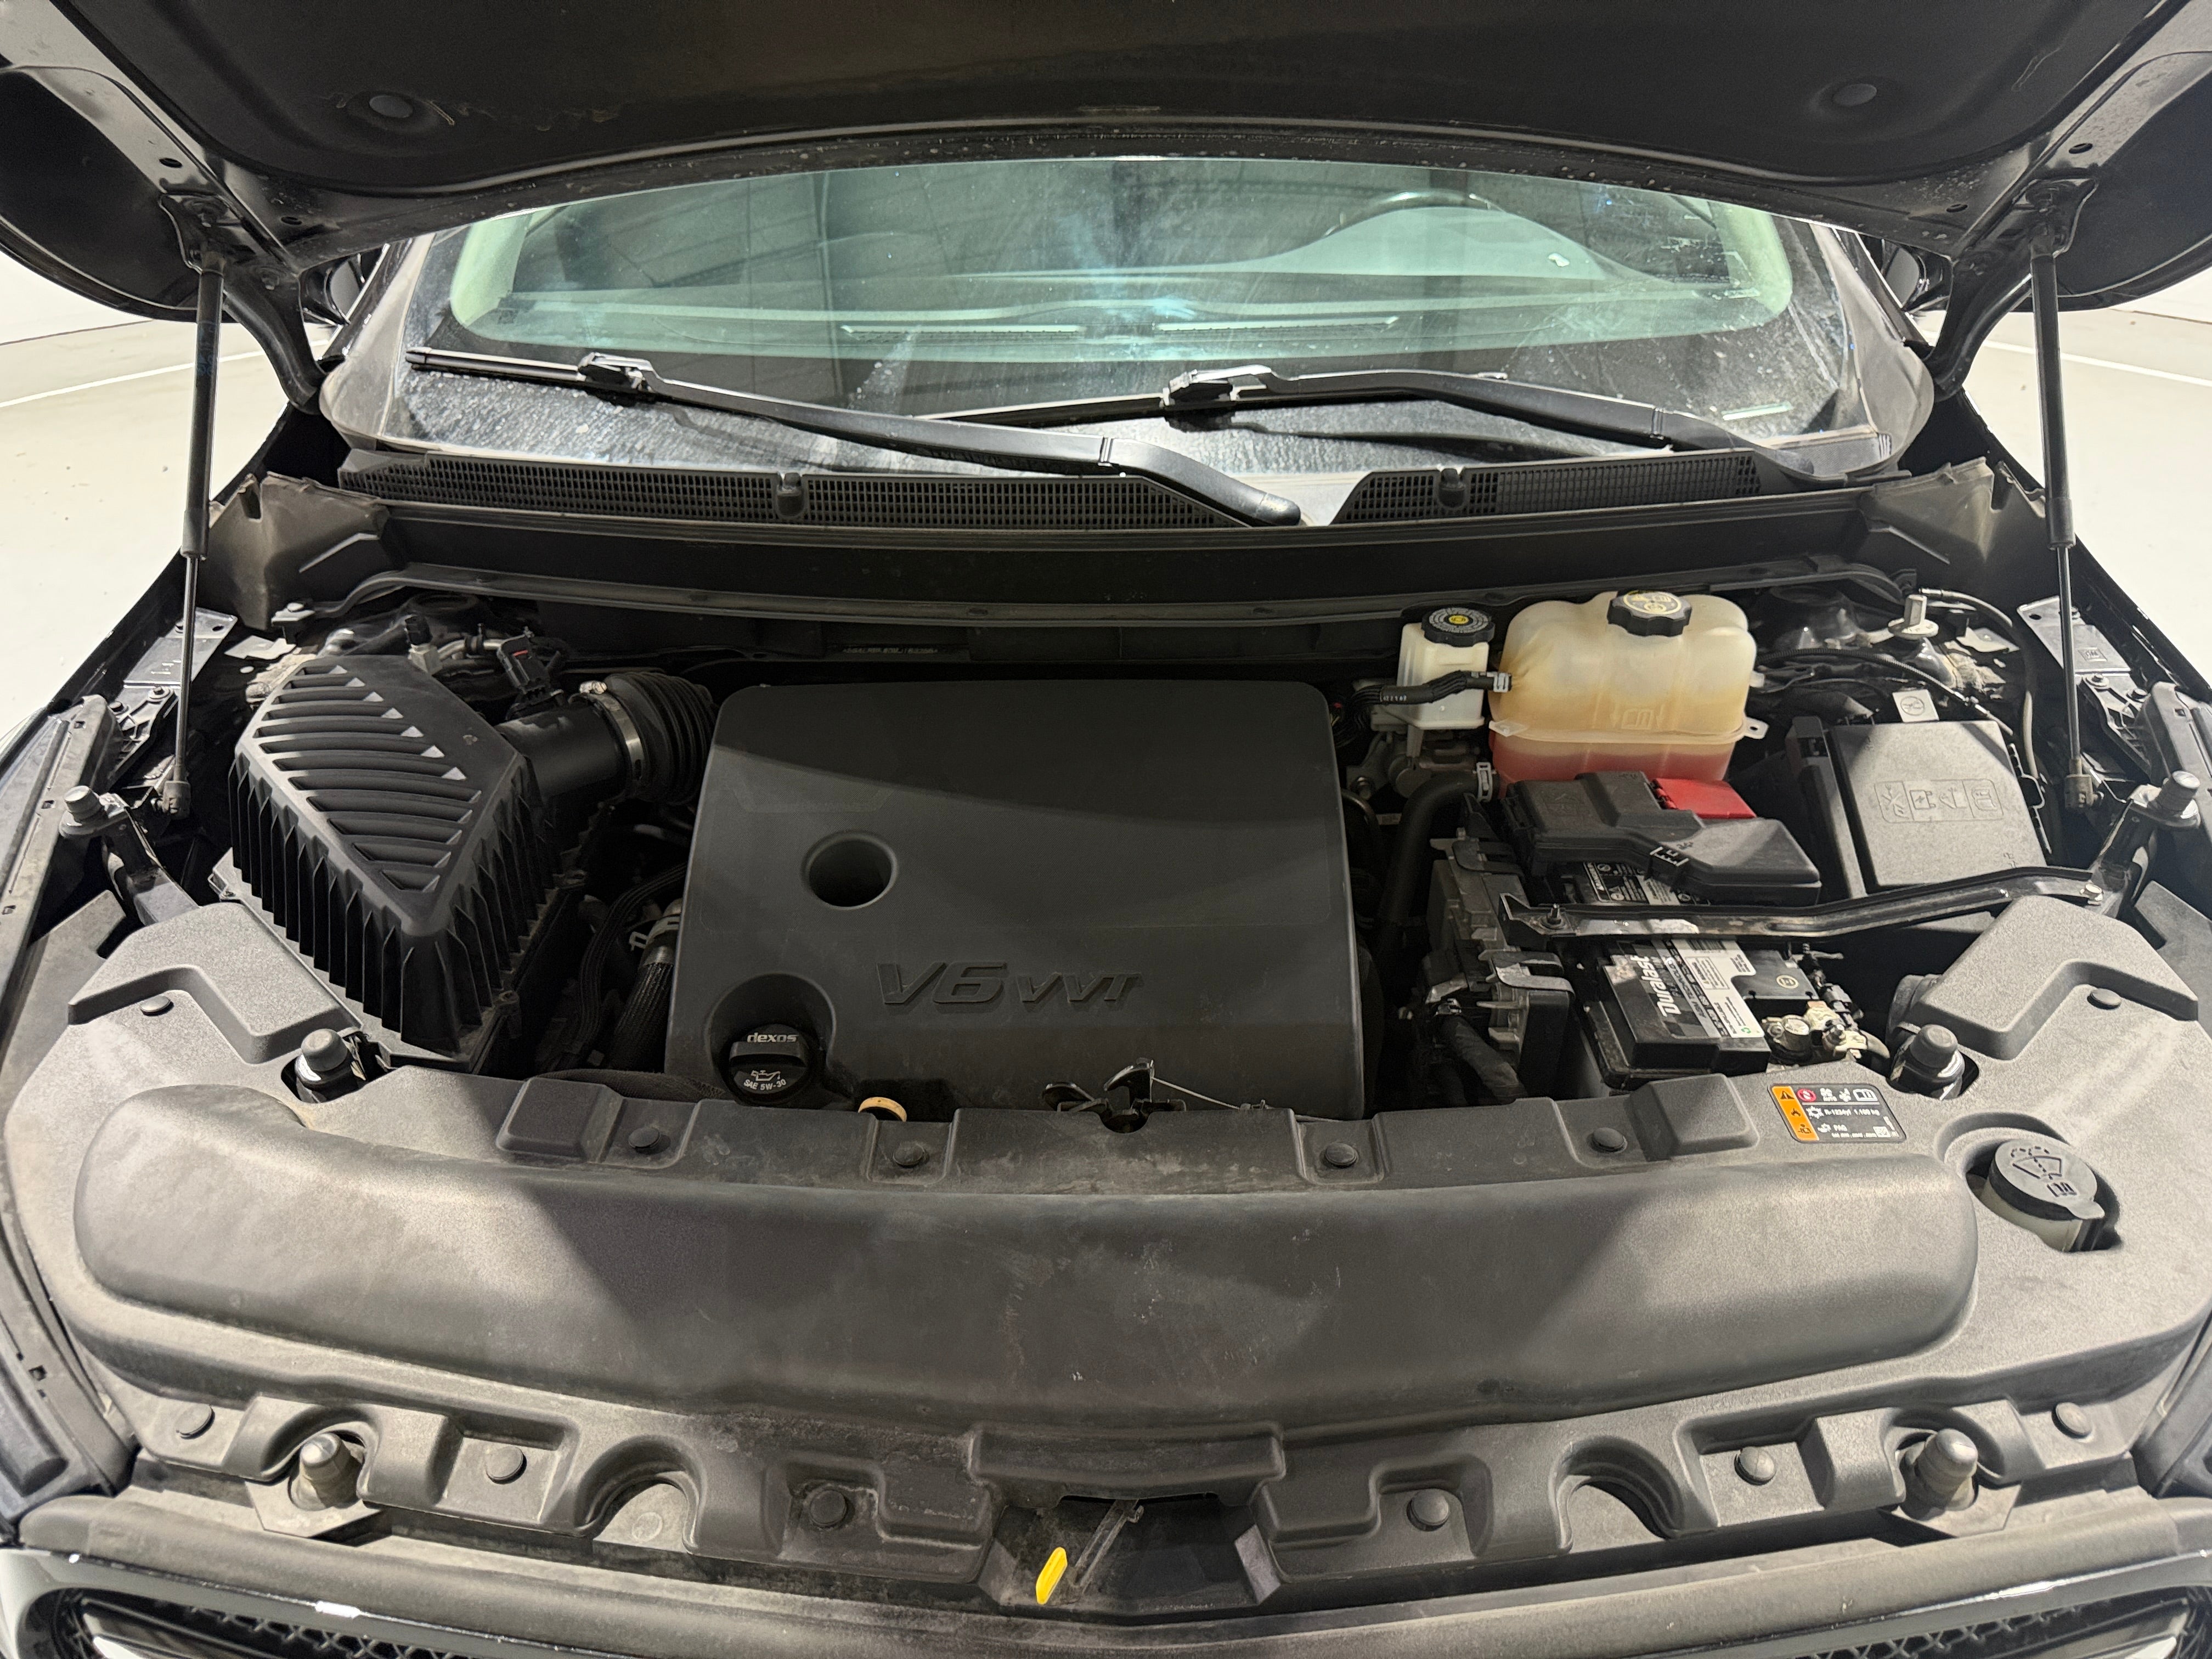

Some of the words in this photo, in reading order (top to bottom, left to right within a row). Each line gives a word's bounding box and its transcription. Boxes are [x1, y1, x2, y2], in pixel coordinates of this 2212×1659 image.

[878, 961, 1008, 1004] V6
[1017, 972, 1141, 1003] VVT
[1630, 955, 1681, 1017] Duralast
[747, 1032, 799, 1043] dexos
[743, 1079, 759, 1090] SAE
[760, 1079, 787, 1091] 5W-30
